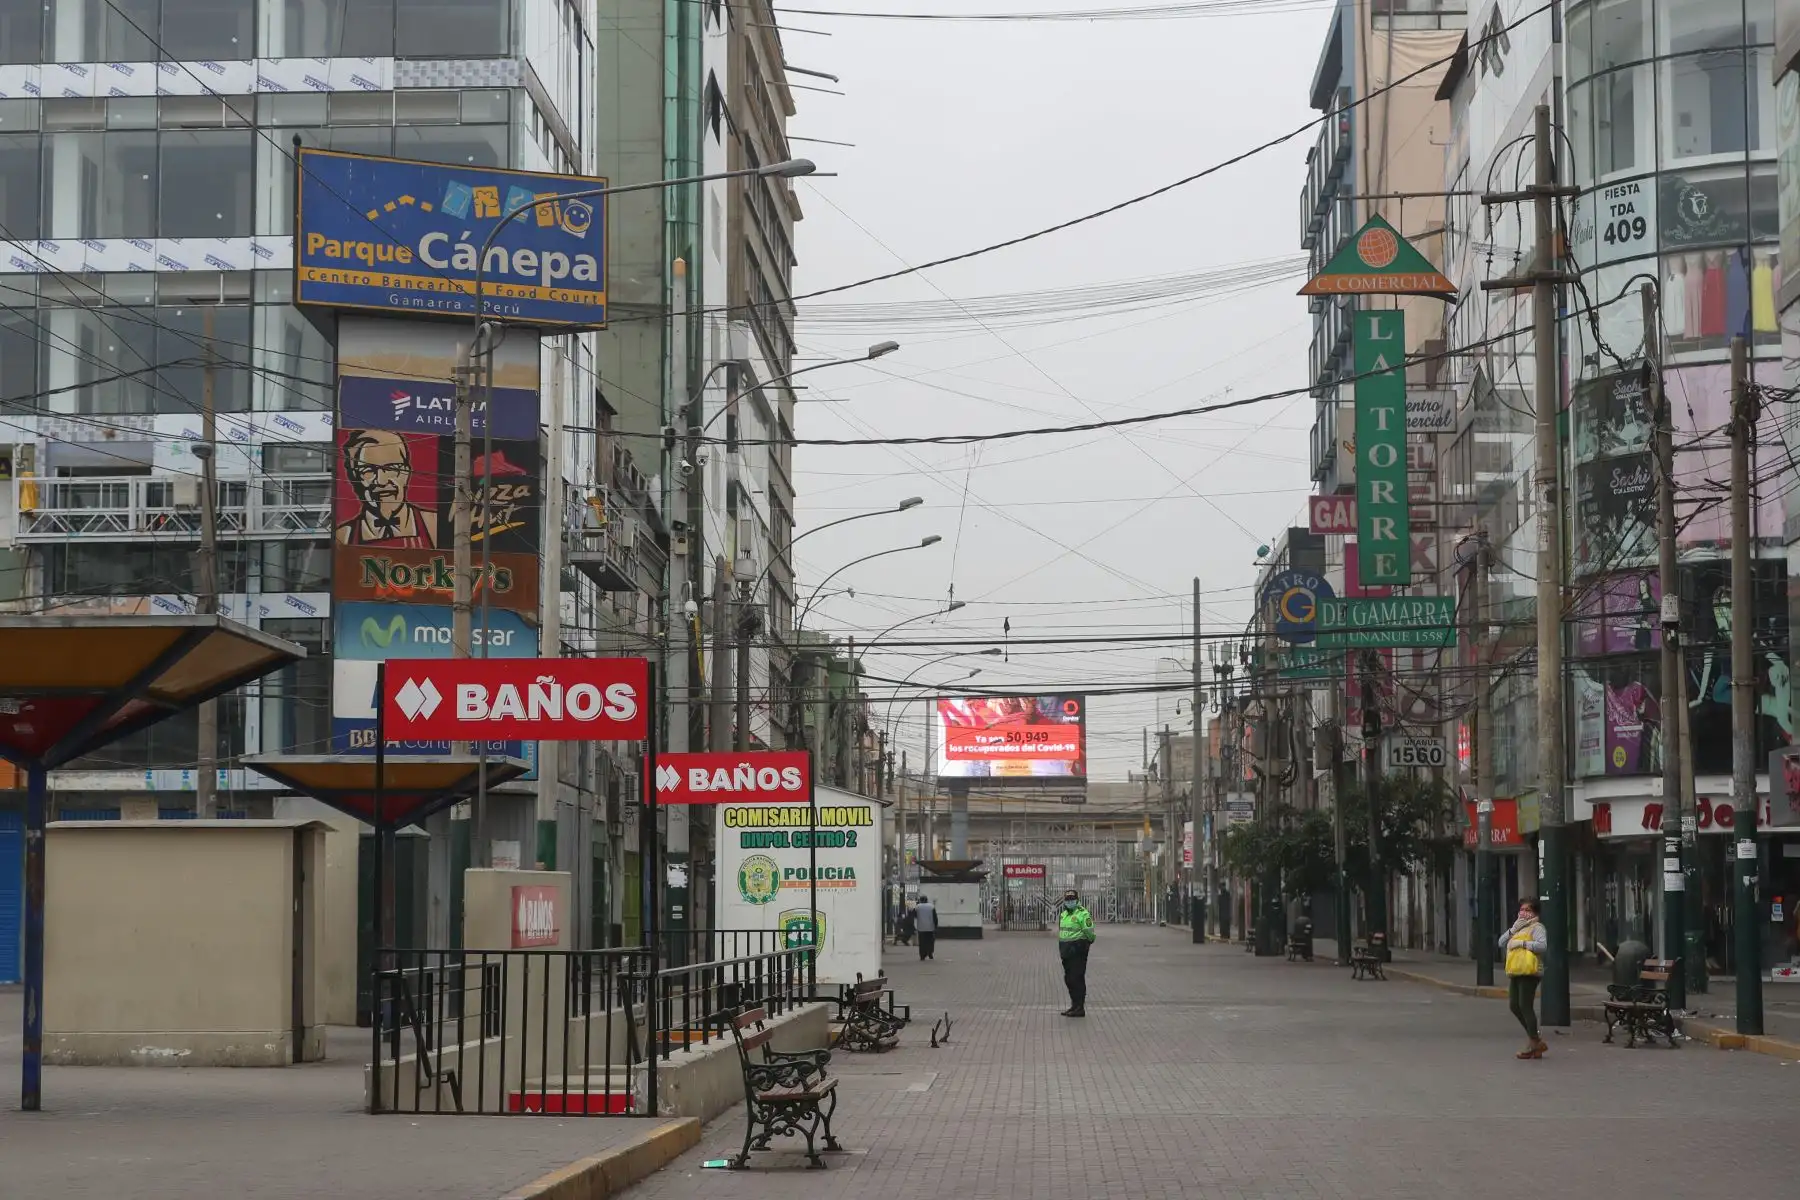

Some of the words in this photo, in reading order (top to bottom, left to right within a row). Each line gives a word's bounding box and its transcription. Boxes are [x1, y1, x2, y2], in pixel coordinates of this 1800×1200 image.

[1605, 184, 1640, 200] FIESTA
[1610, 202, 1635, 217] TDA
[1604, 216, 1646, 245] 409
[307, 233, 412, 266] Parque
[418, 231, 598, 287] Cánepa
[307, 269, 370, 285] Centro
[382, 276, 464, 294] Bancario
[495, 284, 537, 299] Food
[549, 290, 599, 305] Court
[1316, 277, 1332, 290] C.
[1336, 277, 1442, 290] COMERCIAL
[389, 294, 462, 310] Gamarra
[483, 301, 520, 314] Perú
[416, 396, 486, 412] LAT
[1406, 399, 1442, 412] entro
[1406, 408, 1453, 428] ercial
[1367, 407, 1399, 577] TORRE
[1613, 485, 1646, 495] COLLECTIO
[1315, 500, 1357, 528] GA
[1322, 602, 1347, 627] DE
[1353, 601, 1451, 627] GAMARRA
[414, 626, 514, 647] mosar
[1350, 631, 1411, 643] UNANUE
[1416, 632, 1444, 643] 1558
[457, 675, 638, 722] BAÑOS
[975, 735, 986, 743] Ya
[1006, 731, 1049, 744] 50,949
[949, 744, 963, 752] los
[1392, 747, 1442, 763] 1560
[688, 762, 803, 792] BAÑOS
[724, 807, 819, 828] COMISARIA
[820, 806, 873, 827] MOVIL
[740, 831, 790, 849] DIVPOL
[792, 830, 845, 849] CETRO
[846, 830, 857, 848] 2
[1015, 866, 1043, 875] BAÑOS
